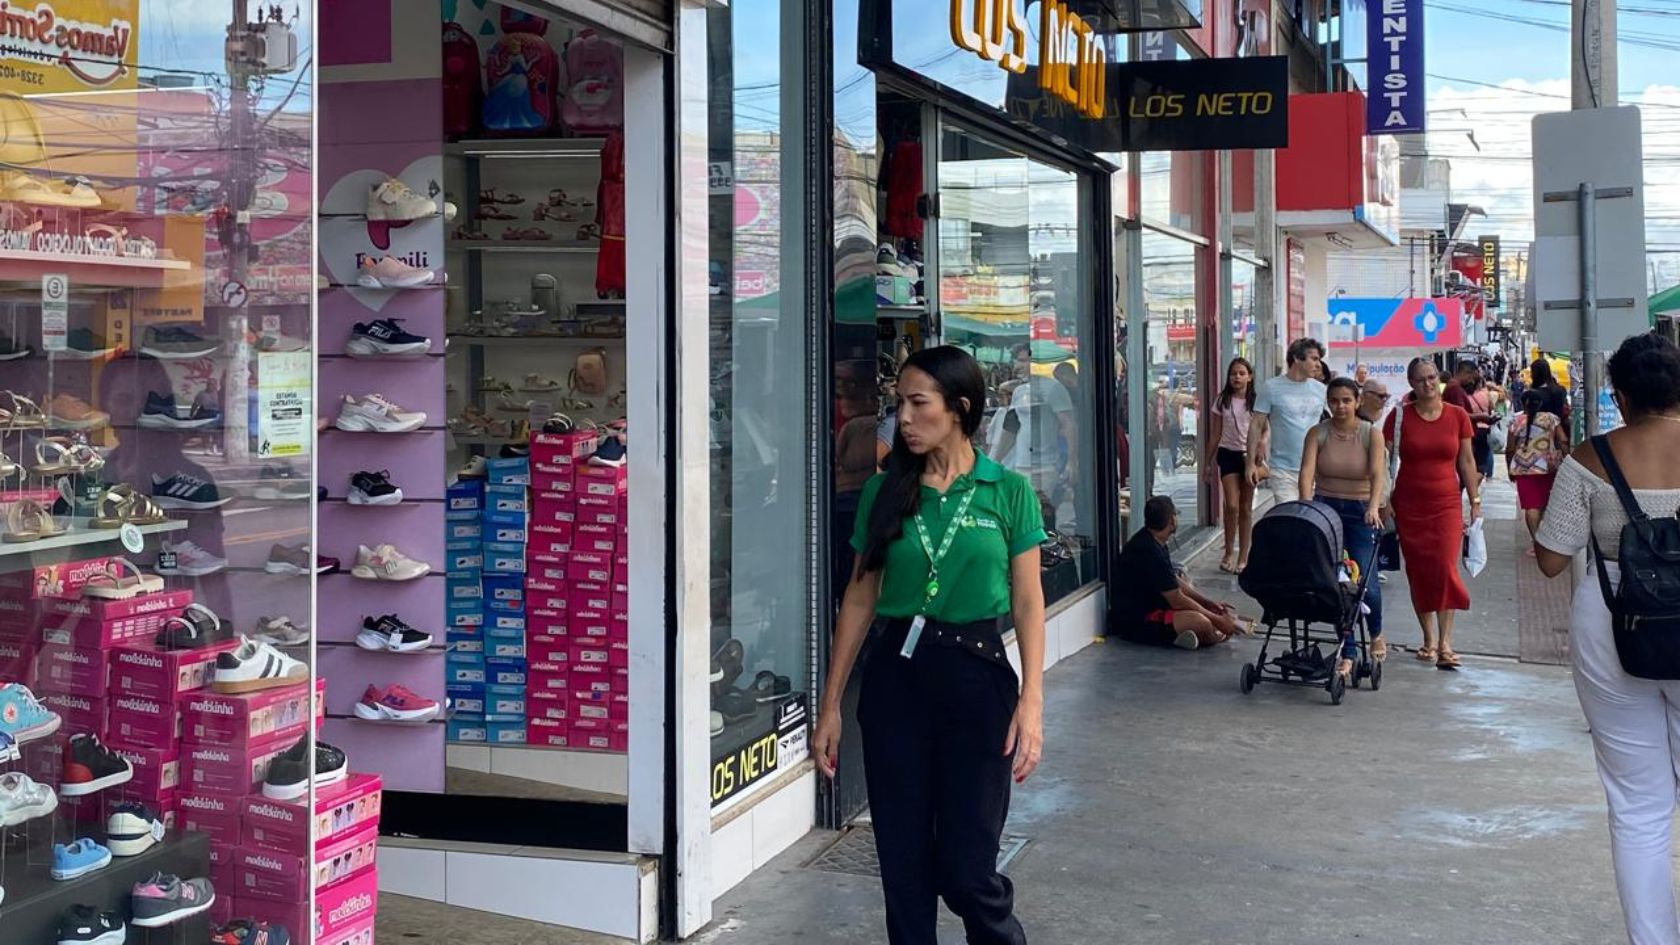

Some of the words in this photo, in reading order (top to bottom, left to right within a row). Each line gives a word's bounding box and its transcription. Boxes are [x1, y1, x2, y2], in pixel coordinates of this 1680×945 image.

[1129, 94, 1185, 118] LOS
[1196, 91, 1273, 116] NETO
[1483, 242, 1495, 274] NETO
[368, 326, 392, 340] FILA
[710, 755, 736, 803] OS
[739, 733, 778, 785] NETO
